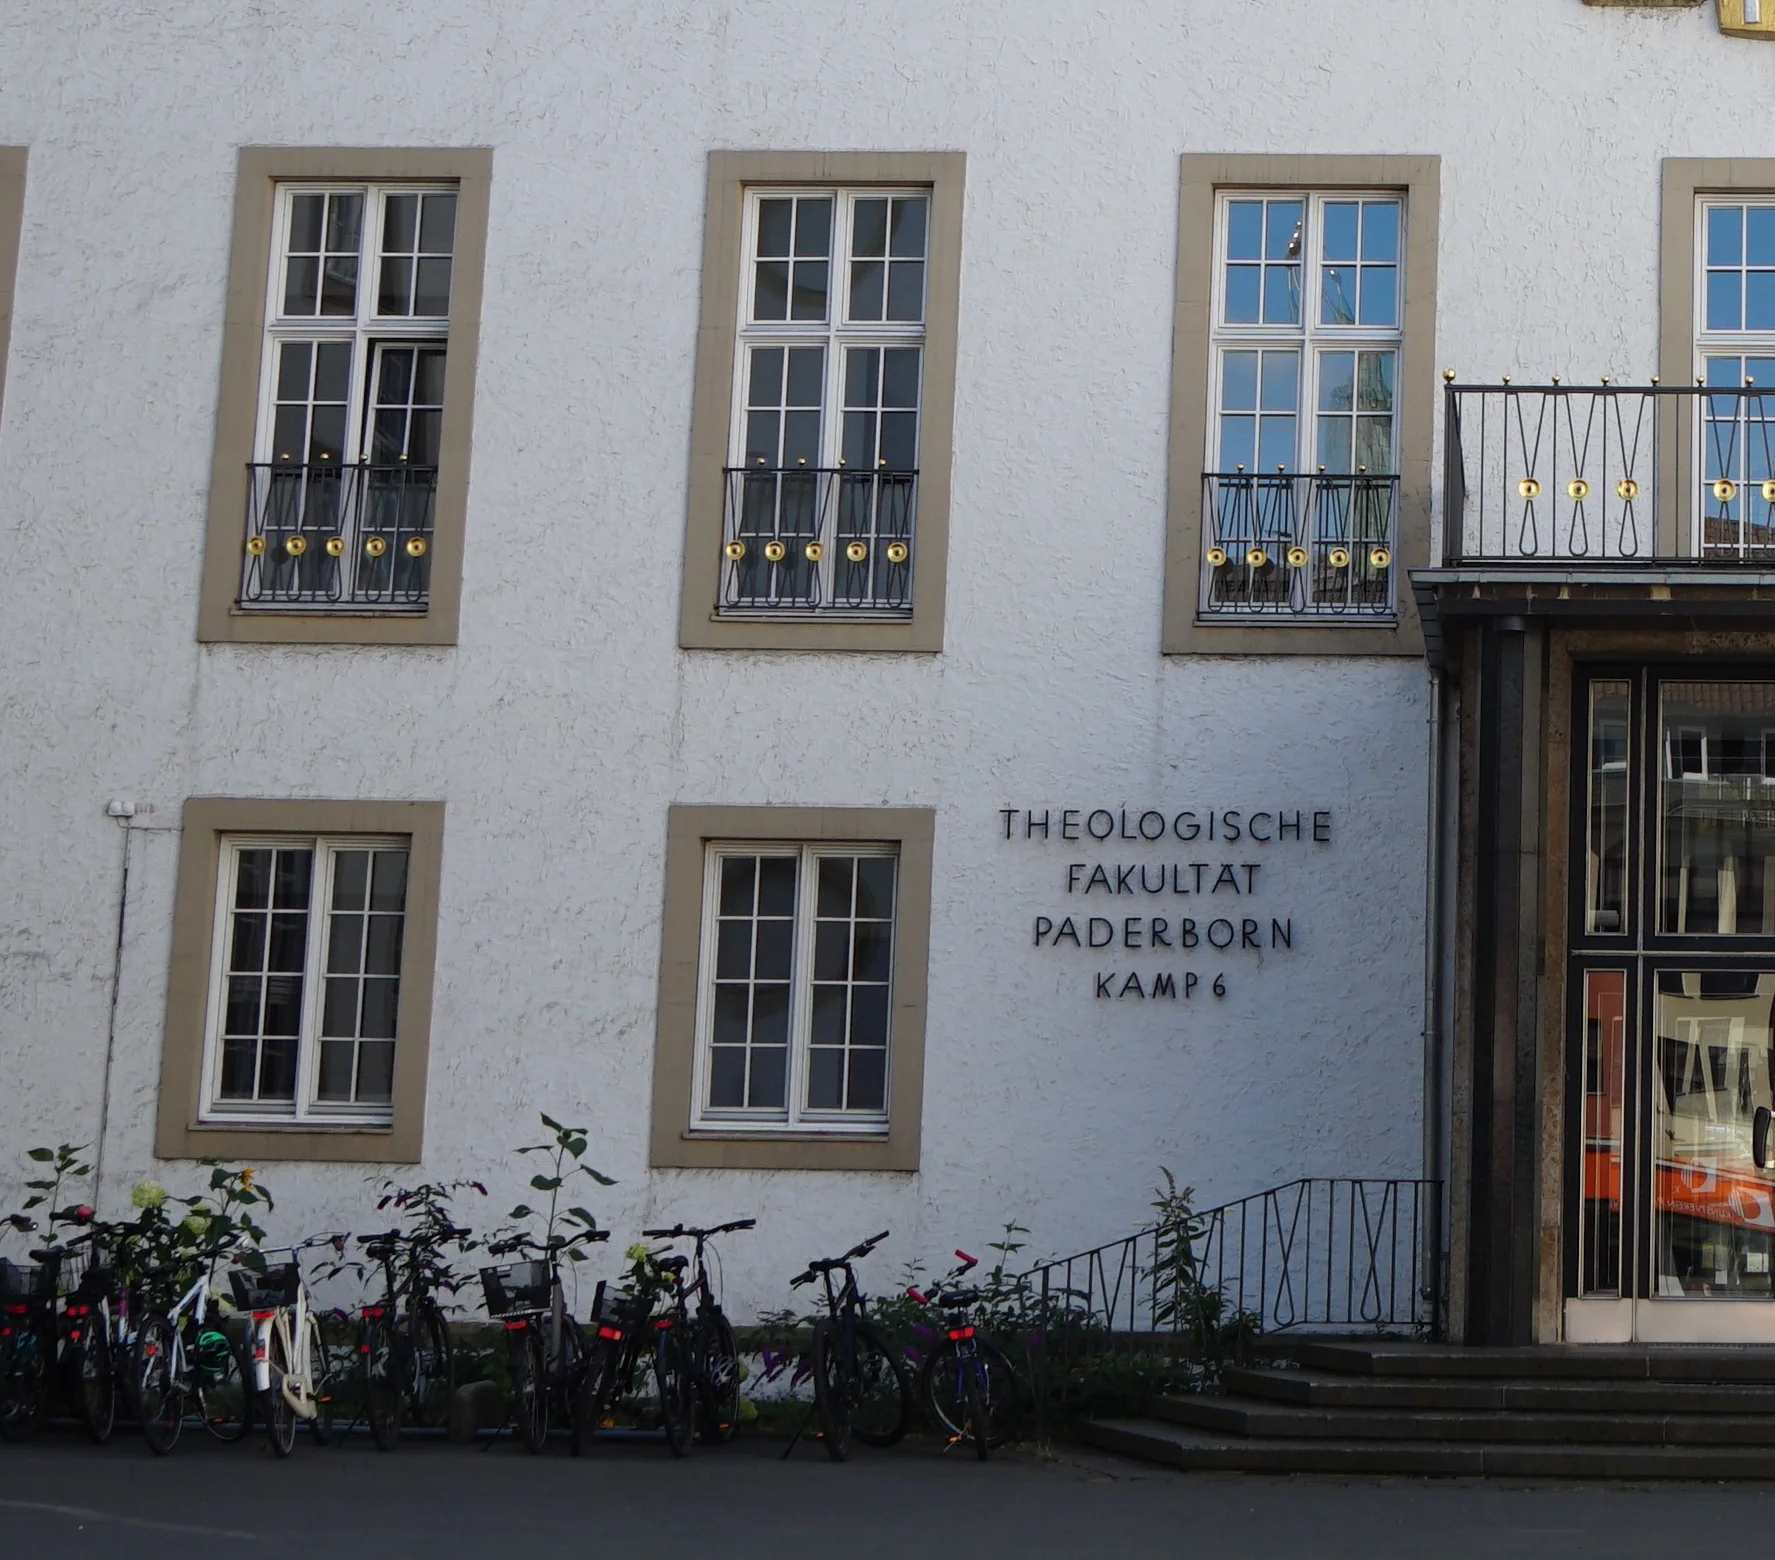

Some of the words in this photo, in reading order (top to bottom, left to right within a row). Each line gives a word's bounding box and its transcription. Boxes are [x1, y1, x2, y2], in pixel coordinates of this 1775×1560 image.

[1000, 808, 1332, 842] THEOLOGISCHE
[1066, 862, 1262, 895] FAKULTÄT
[1034, 916, 1294, 949] PADERBORN
[1096, 970, 1197, 1000] KAMP
[1212, 971, 1227, 998] 6
